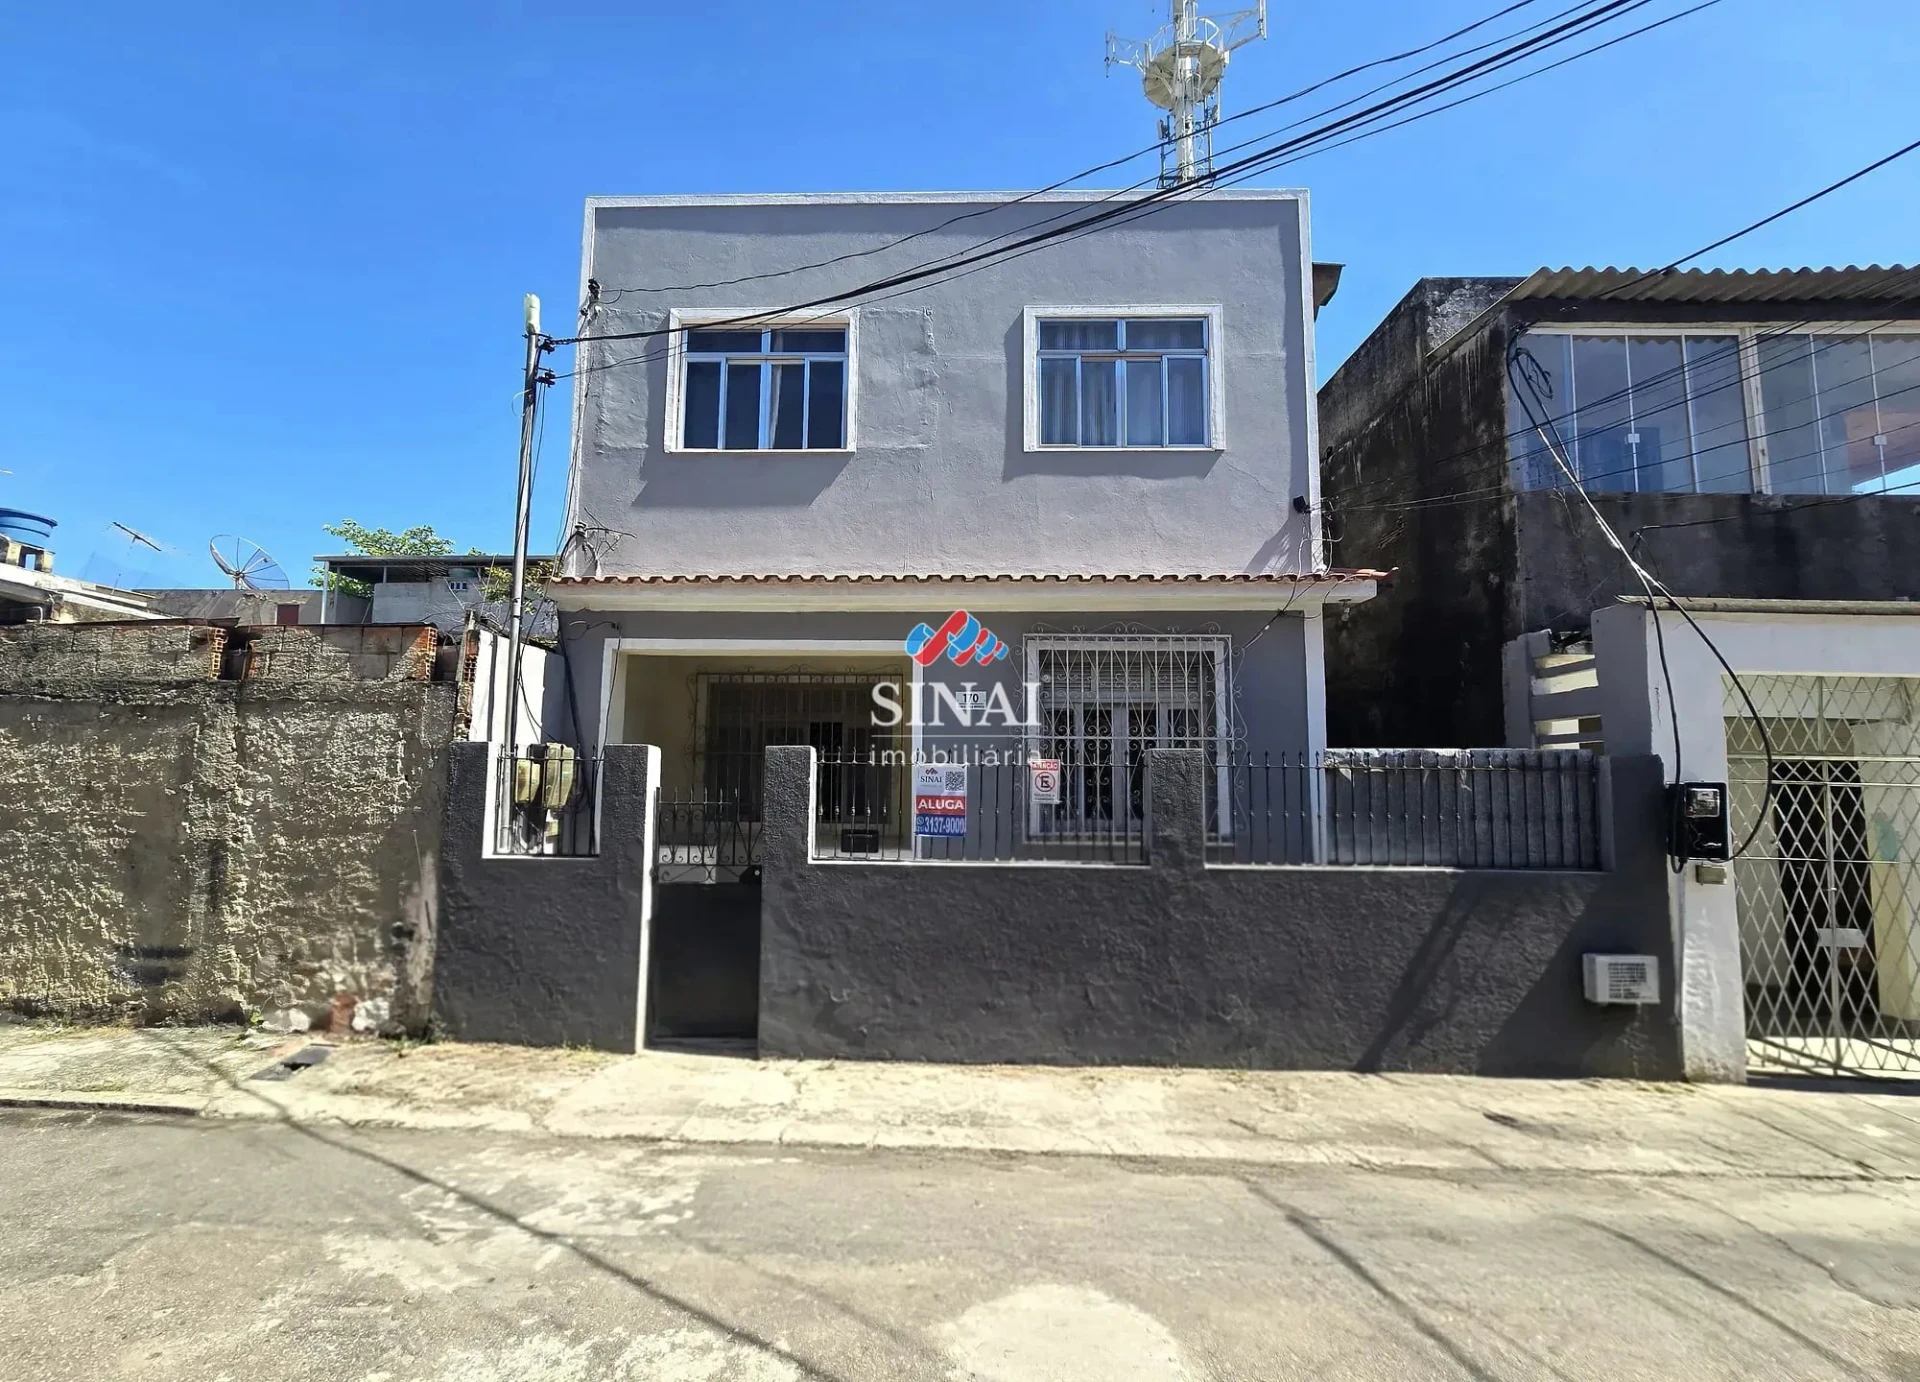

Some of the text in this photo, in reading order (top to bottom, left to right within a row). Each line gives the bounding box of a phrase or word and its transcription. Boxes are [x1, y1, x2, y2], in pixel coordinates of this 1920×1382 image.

[920, 775, 942, 783] SINAI
[917, 798, 965, 810] ALUGA
[924, 816, 965, 834] 3137-9000
